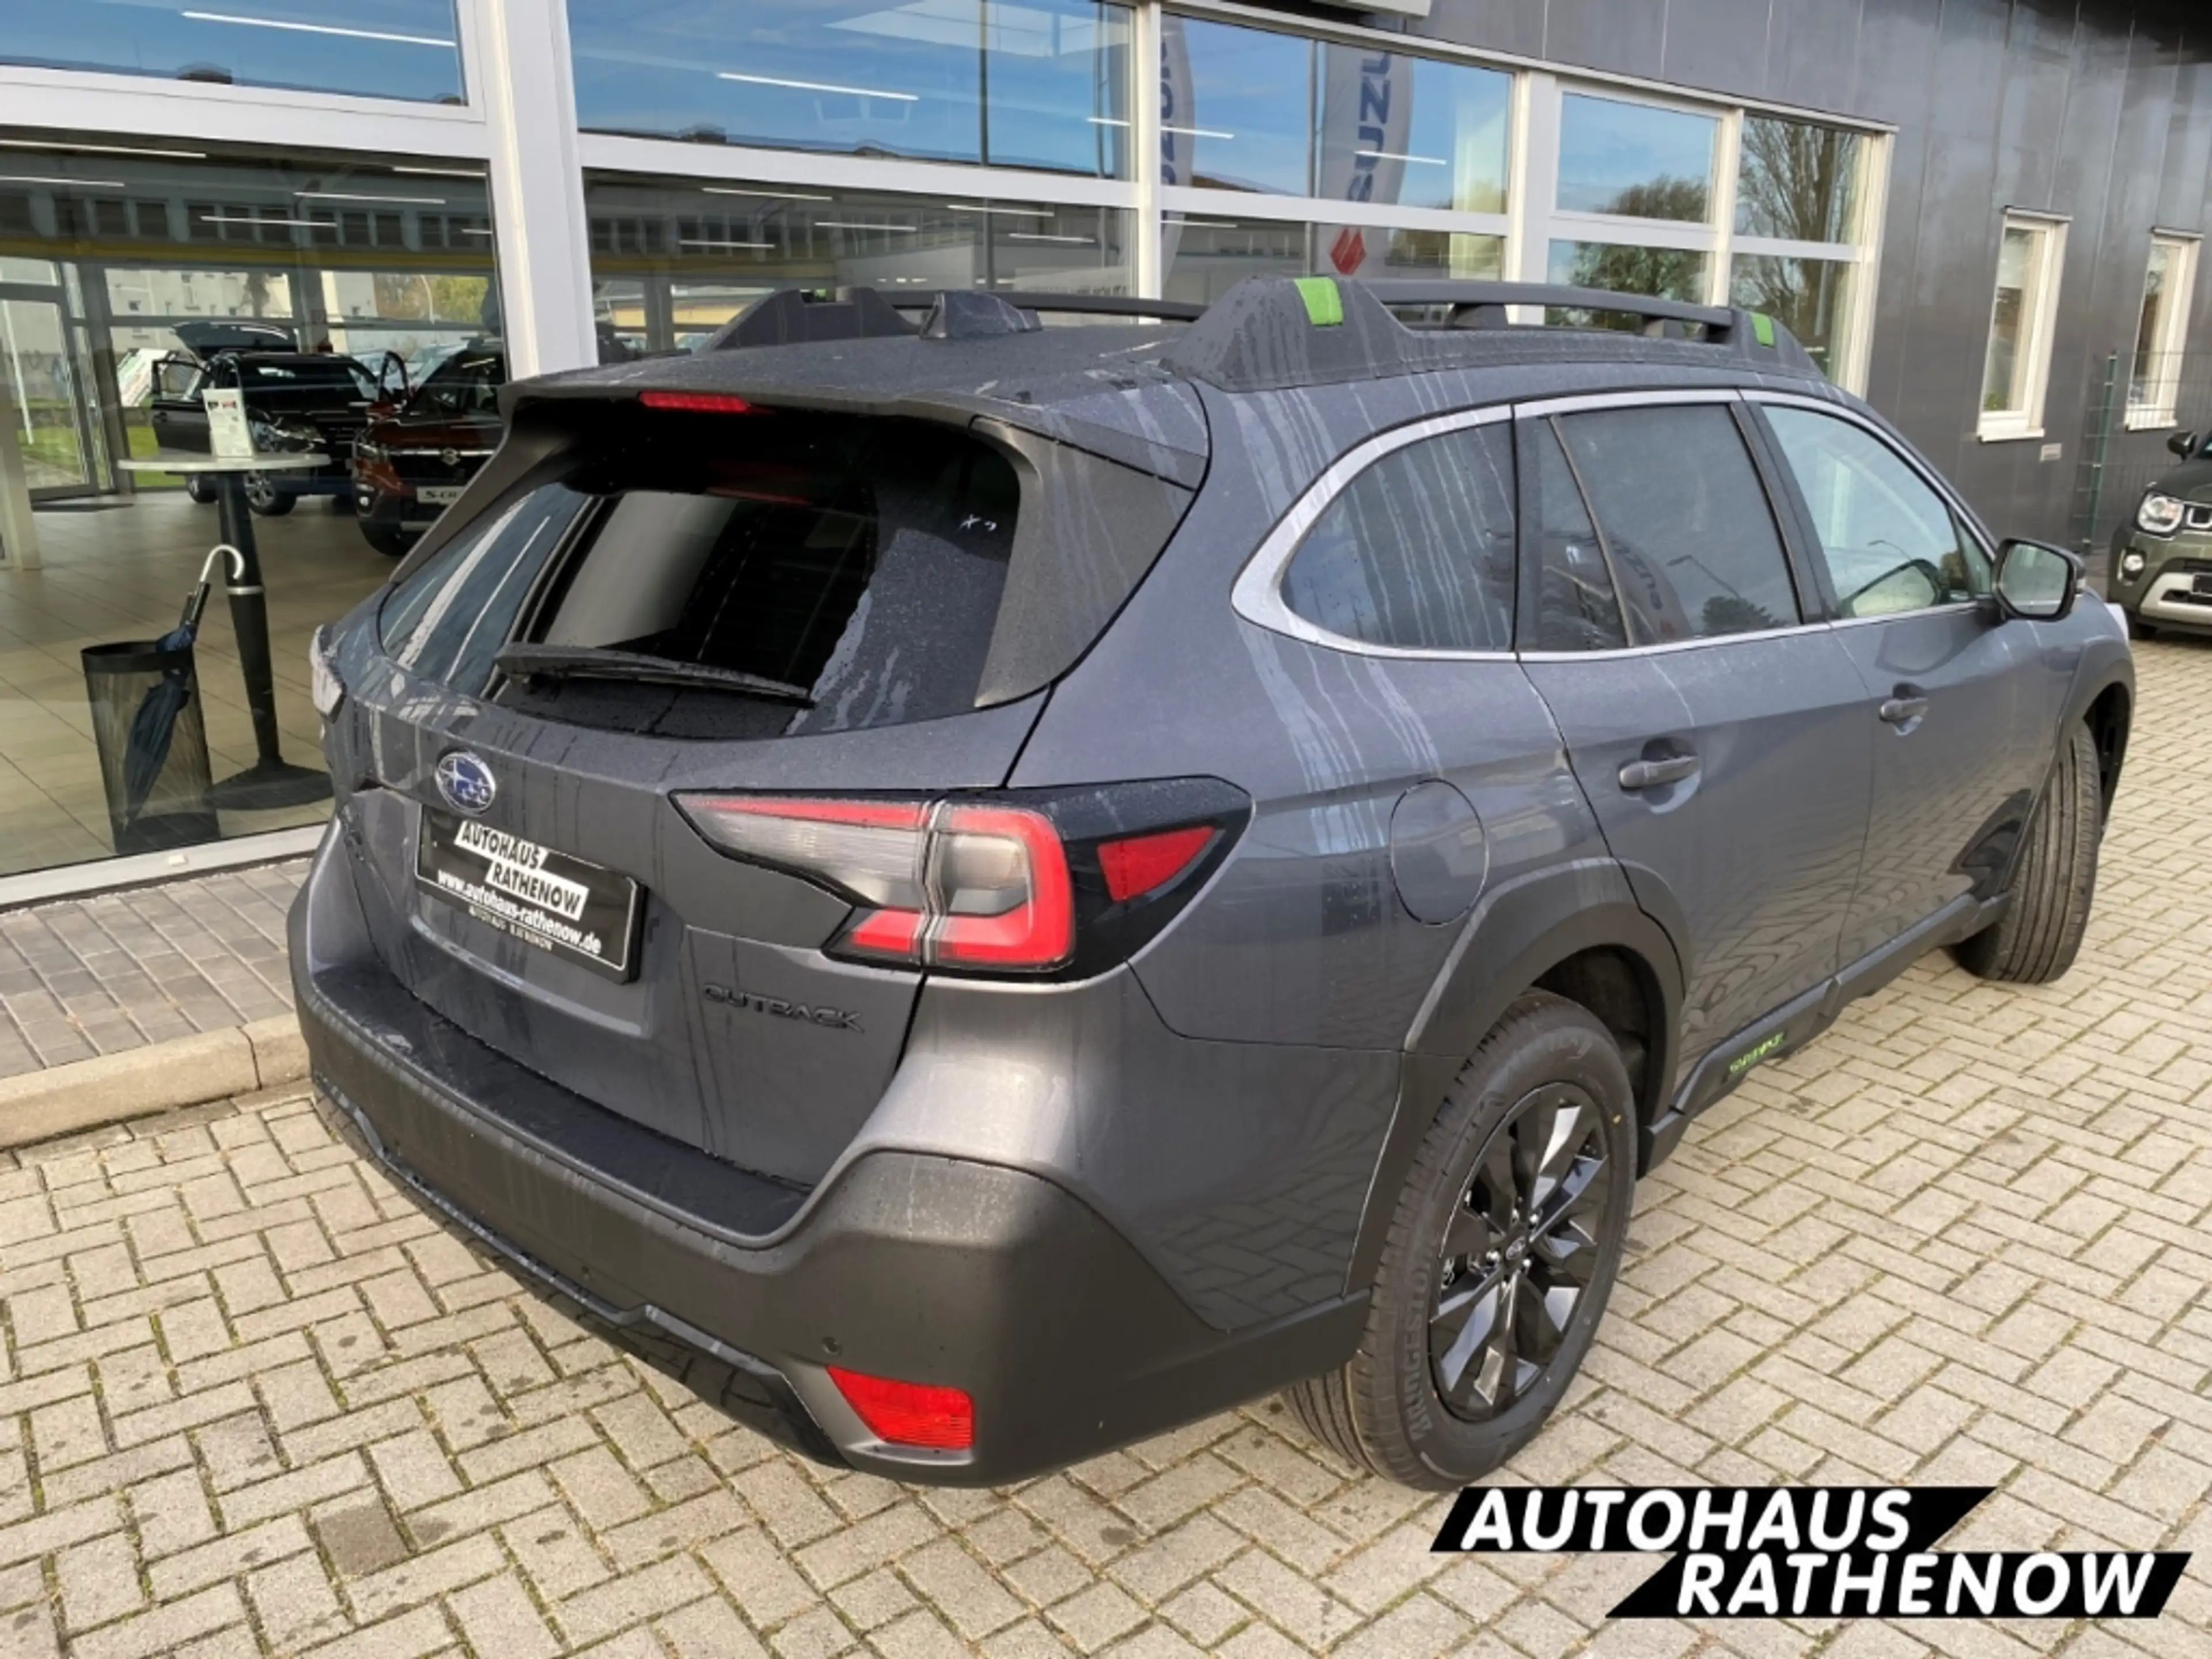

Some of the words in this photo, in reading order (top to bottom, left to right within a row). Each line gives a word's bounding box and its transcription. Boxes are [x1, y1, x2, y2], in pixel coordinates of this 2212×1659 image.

[461, 822, 541, 869] AUTOHAUS
[438, 870, 601, 954] www.autohaus-rathenow.de
[492, 862, 582, 915] RATHENOW
[703, 983, 865, 1033] OUTBACK
